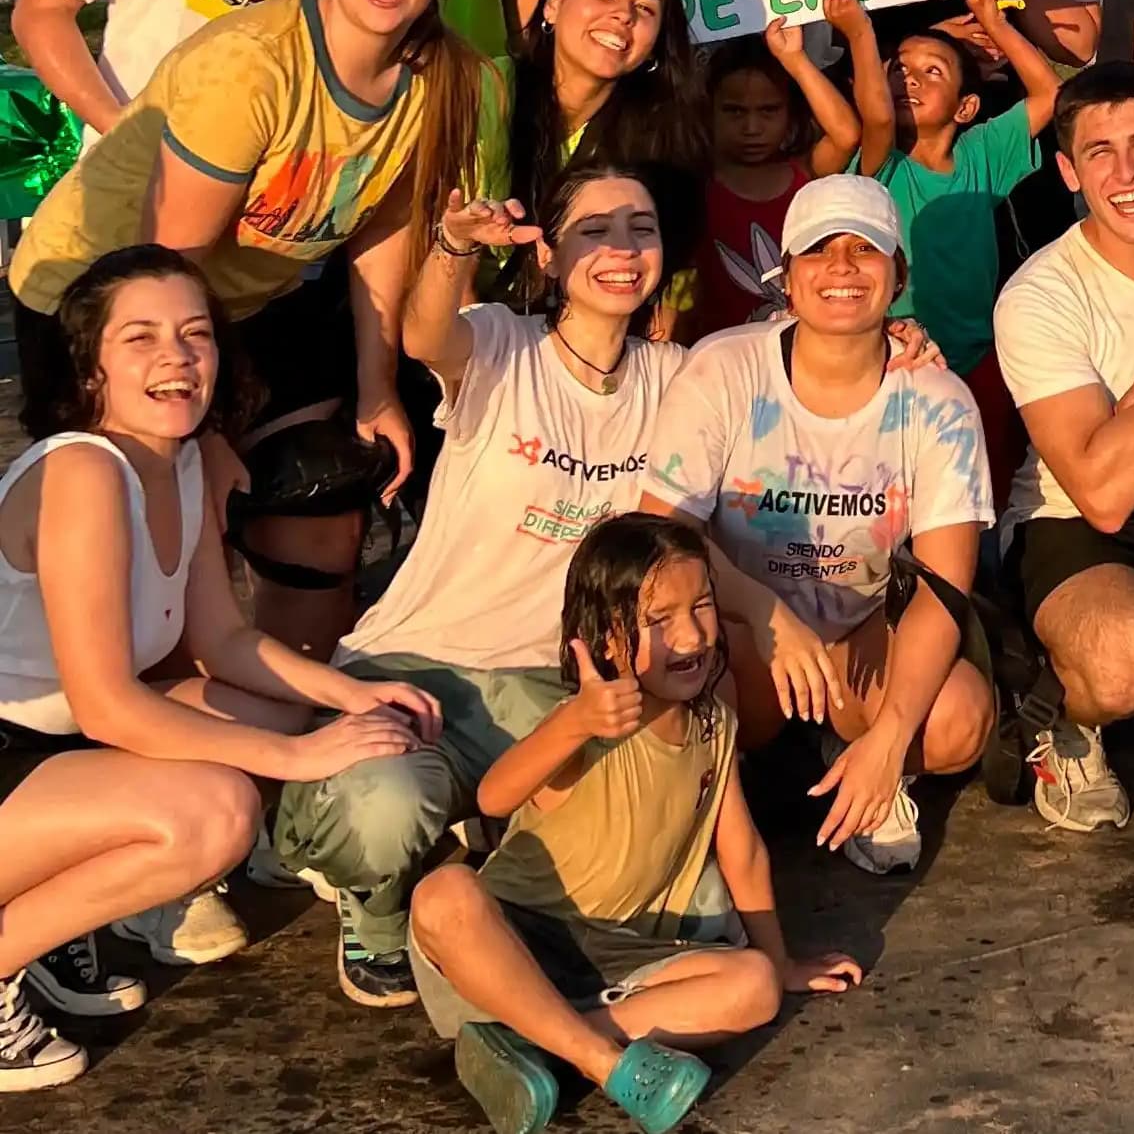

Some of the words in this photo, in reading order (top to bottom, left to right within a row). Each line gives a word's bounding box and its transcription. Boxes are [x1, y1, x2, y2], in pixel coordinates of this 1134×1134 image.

[758, 488, 886, 517] ACTIVEMOS
[786, 542, 844, 558] SIENDO
[768, 560, 857, 579] DIFERENTES
